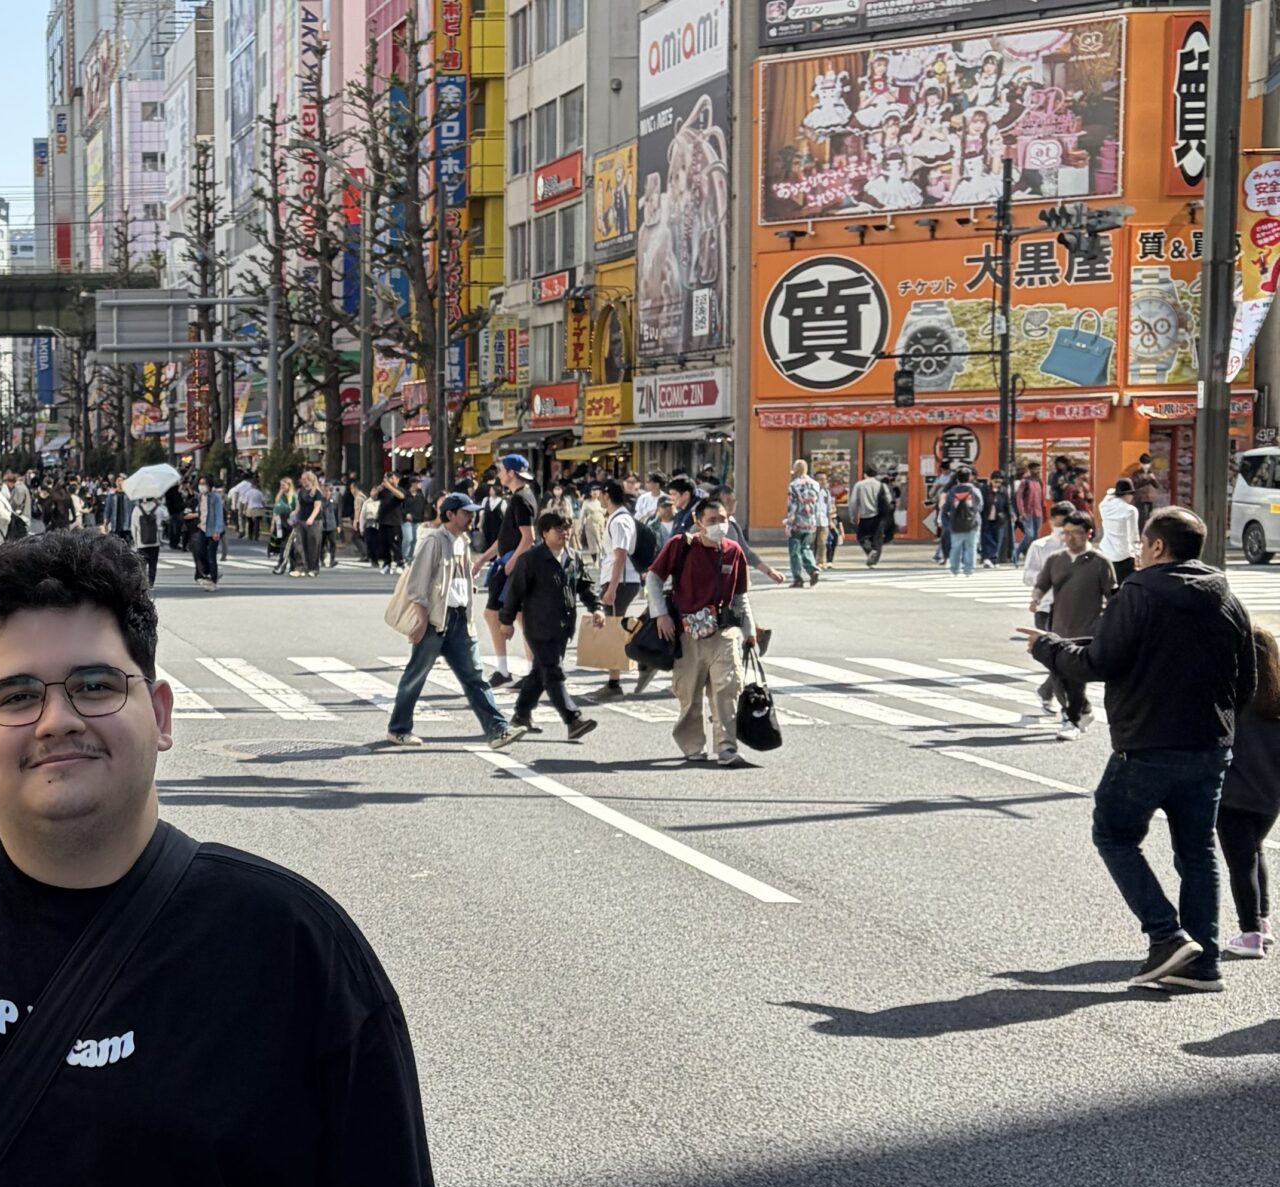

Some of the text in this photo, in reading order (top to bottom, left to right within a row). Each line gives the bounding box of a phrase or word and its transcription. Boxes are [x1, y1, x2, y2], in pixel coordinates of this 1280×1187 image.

[302, 6, 319, 77] AKKY
[649, 8, 719, 76] amiami
[898, 280, 955, 295] チケット
[964, 233, 1114, 291] 大黒屋
[778, 273, 874, 374] 質
[660, 383, 704, 407] COMIC ZIN
